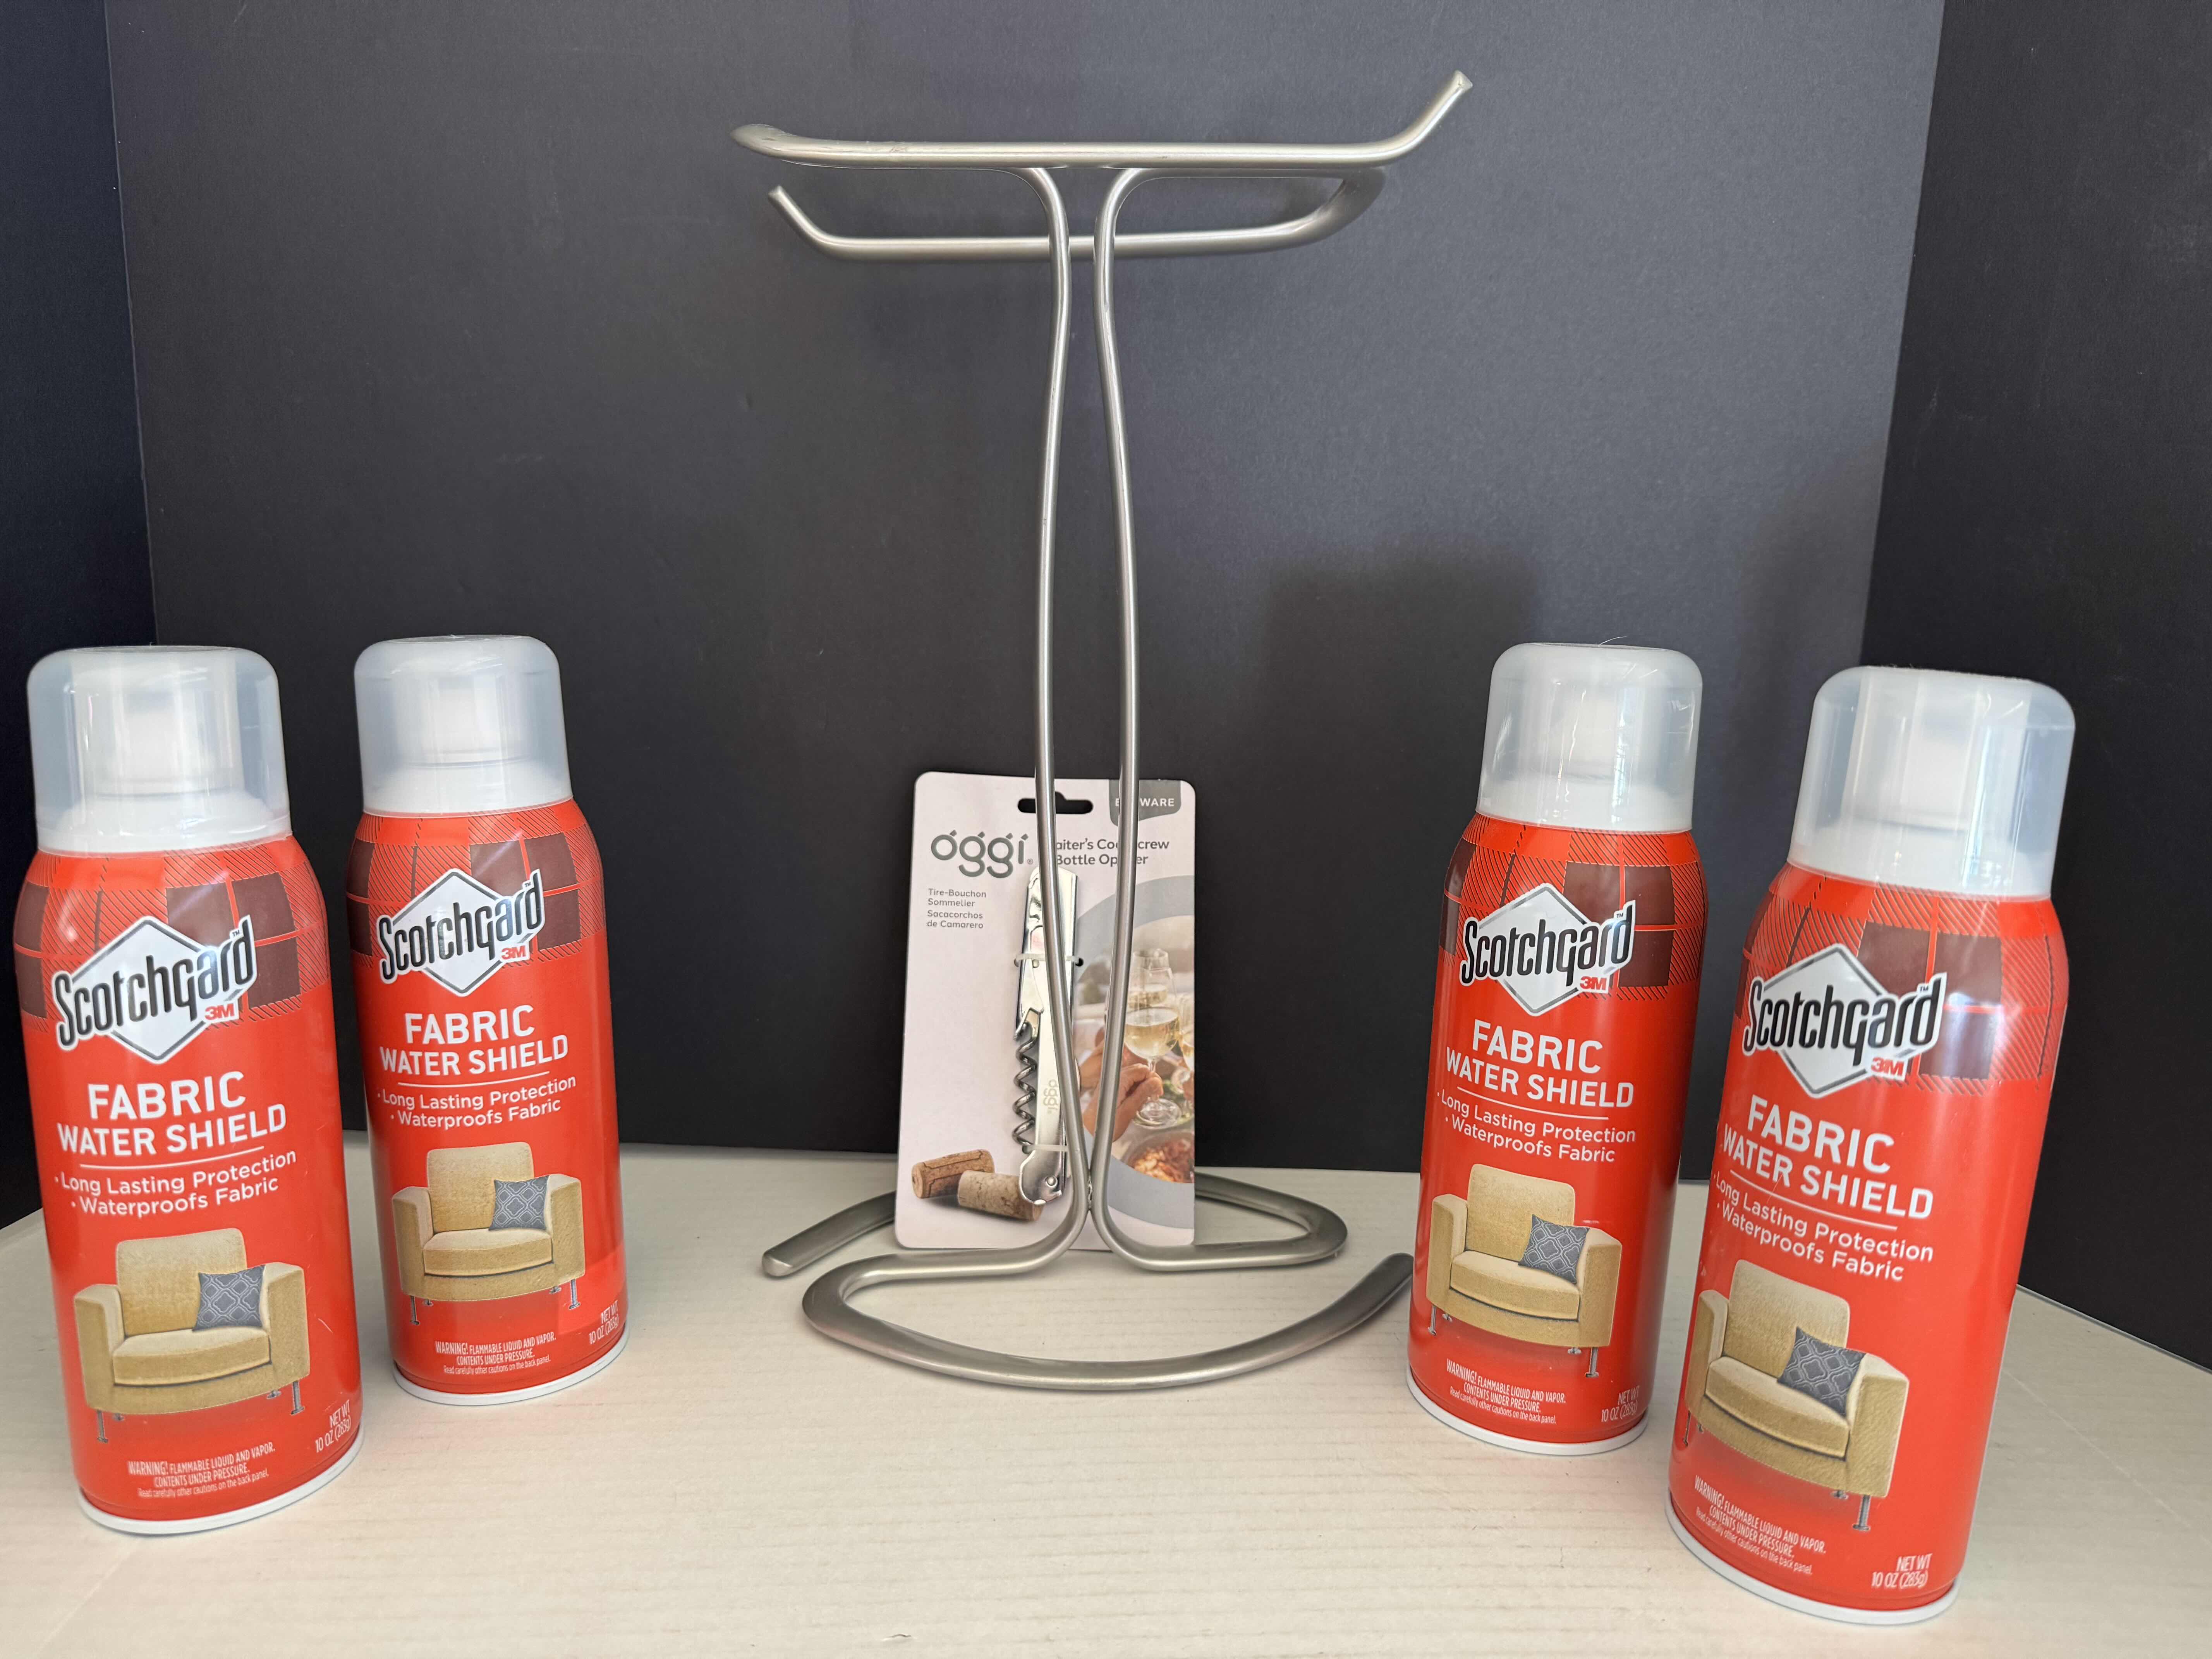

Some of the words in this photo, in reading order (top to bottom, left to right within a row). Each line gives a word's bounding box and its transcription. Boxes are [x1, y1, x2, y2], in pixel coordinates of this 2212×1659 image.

[1115, 798, 1175, 807] BWARE
[1056, 838, 1093, 850] aiter's
[1097, 839, 1169, 850] Cocrew
[1057, 854, 1096, 865] Bottle
[1099, 854, 1148, 866] Oper
[928, 898, 975, 907] Sommelier
[929, 888, 986, 897] Tire-Bouchon
[380, 872, 542, 980] Scotchgard
[927, 910, 983, 919] Sacacorchos
[941, 920, 983, 929] Camarero
[501, 946, 527, 960] 3M
[1462, 905, 1633, 986] Scotchgard
[55, 920, 252, 1047] Scotchgard
[1580, 976, 1607, 990] 3M
[204, 1003, 235, 1021] 3M
[405, 1005, 535, 1045] FABRIC
[1744, 977, 1942, 1066] Scotchgard
[380, 1046, 461, 1076] WATER
[469, 1035, 568, 1075] SHIELD
[1473, 1019, 1602, 1074] FABRIC
[1446, 1046, 1518, 1096] WATER
[1527, 1073, 1634, 1108] SHIELD
[1871, 1057, 1904, 1077] 3M
[88, 1071, 246, 1120] FABRIC
[383, 1090, 414, 1110] Long
[420, 1094, 483, 1111] Lasting
[491, 1076, 576, 1105] Protection
[57, 1123, 157, 1156] WATER
[167, 1104, 286, 1151] SHIELD
[398, 1109, 503, 1130] Waterproofs
[509, 1098, 561, 1122] Fabric
[1442, 1089, 1469, 1118] Long
[1474, 1108, 1535, 1139] Lasting
[1543, 1121, 1635, 1143] Protection
[1452, 1117, 1552, 1158] Waterproofs
[1559, 1145, 1615, 1163] Fabric
[1747, 1094, 1894, 1173] FABRIC
[61, 1173, 101, 1195] Long
[108, 1175, 184, 1195] Lasting
[194, 1150, 296, 1187] Protection
[1723, 1123, 1793, 1188] WATER
[1801, 1165, 1934, 1219] SHIELD
[79, 1192, 208, 1218] Waterproofs
[216, 1176, 278, 1206] Fabric
[1716, 1171, 1740, 1207] Long
[1743, 1190, 1807, 1237] Lasting
[1815, 1222, 1934, 1263] Protection
[1722, 1202, 1824, 1264] Waterproofs
[1832, 1247, 1904, 1281] Fabric
[601, 1306, 610, 1324] NET
[611, 1300, 618, 1316] WT
[435, 1341, 468, 1355] WARNING!
[469, 1343, 502, 1354] FLAMMABLE
[503, 1340, 522, 1352] LIQUID
[523, 1336, 535, 1348] AND
[536, 1331, 556, 1345] VAPOR.
[589, 1331, 596, 1344] 10
[597, 1325, 605, 1340] OZ
[444, 1365, 454, 1374] Read
[516, 1360, 524, 1369] the
[525, 1358, 535, 1367] back
[457, 1355, 484, 1365] CONTENTS
[485, 1354, 503, 1364] UNDER
[505, 1348, 535, 1362] PRESSURE.
[1447, 1358, 1477, 1384] WARNING!
[1477, 1376, 1510, 1395] FLAMMABLE
[1511, 1386, 1530, 1399] LIQUID
[1531, 1390, 1544, 1401] AND
[1545, 1391, 1566, 1403] VAPOR.
[1618, 1389, 1630, 1405] NET
[1631, 1385, 1639, 1400] WT
[330, 1408, 341, 1428] NET
[341, 1399, 350, 1418] WT
[1450, 1386, 1460, 1398] Read
[1460, 1393, 1479, 1408] carefully
[1479, 1400, 1491, 1411] other
[1492, 1405, 1512, 1417] cautions
[1520, 1410, 1528, 1420] the
[1529, 1412, 1540, 1422] back
[1541, 1415, 1556, 1424] panel.
[1464, 1382, 1489, 1401] CONTENTS
[1491, 1392, 1510, 1407] UNDER
[1510, 1397, 1541, 1413] PRESSURE.
[1601, 1408, 1609, 1422] 10
[1610, 1407, 1619, 1420] OZ
[315, 1437, 324, 1453] 10
[325, 1429, 334, 1446] OZ
[335, 1415, 351, 1441] (283g)
[128, 1461, 168, 1475] WARNING!
[170, 1459, 210, 1474] FLAMMABLE
[211, 1454, 234, 1469] LIQUID
[236, 1450, 250, 1463] AND
[251, 1442, 275, 1458] VAPOR.
[155, 1475, 187, 1487] CONTENTS
[190, 1472, 211, 1485] UNDER
[214, 1463, 250, 1480] PRESSURE.
[193, 1483, 217, 1495] cautions
[227, 1477, 237, 1487] the
[238, 1474, 251, 1486] back
[1695, 1475, 1724, 1510] WARNING!
[1724, 1501, 1759, 1529] FLAMMABLE
[1760, 1520, 1783, 1539] LIQUID
[1784, 1530, 1799, 1545] AND
[1800, 1536, 1826, 1554] VAPOR.
[1710, 1505, 1735, 1530] CONTENTS
[1737, 1523, 1758, 1543] UNDER
[1759, 1533, 1795, 1558] PRESSURE.
[1760, 1549, 1768, 1559] on
[1769, 1551, 1779, 1563] the
[1896, 1556, 1917, 1571] NET
[1917, 1553, 1933, 1570] WT
[1871, 1571, 1883, 1587] 10
[1884, 1572, 1899, 1588] OZ
